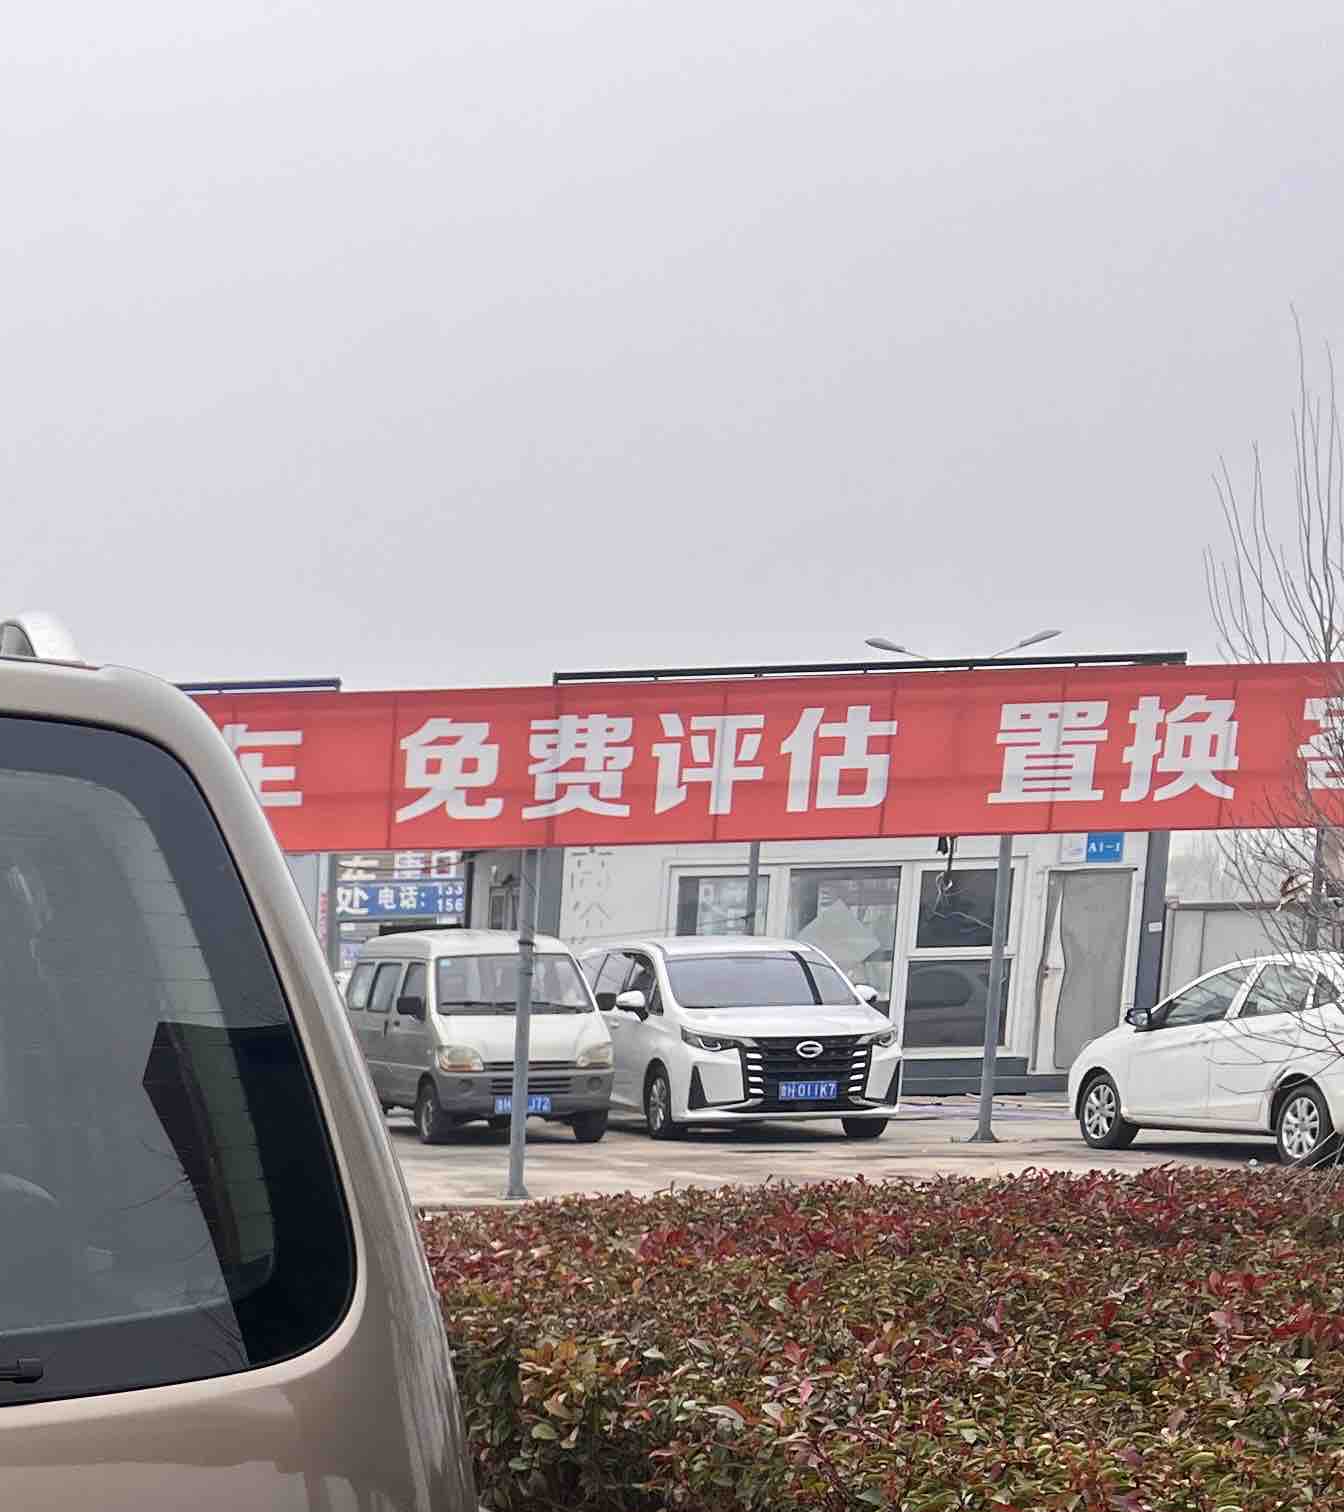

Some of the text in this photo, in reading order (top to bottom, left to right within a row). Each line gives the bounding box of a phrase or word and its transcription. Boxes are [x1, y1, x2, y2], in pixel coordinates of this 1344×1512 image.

[395, 704, 898, 824] 免费评估
[987, 694, 1239, 804] 置换
